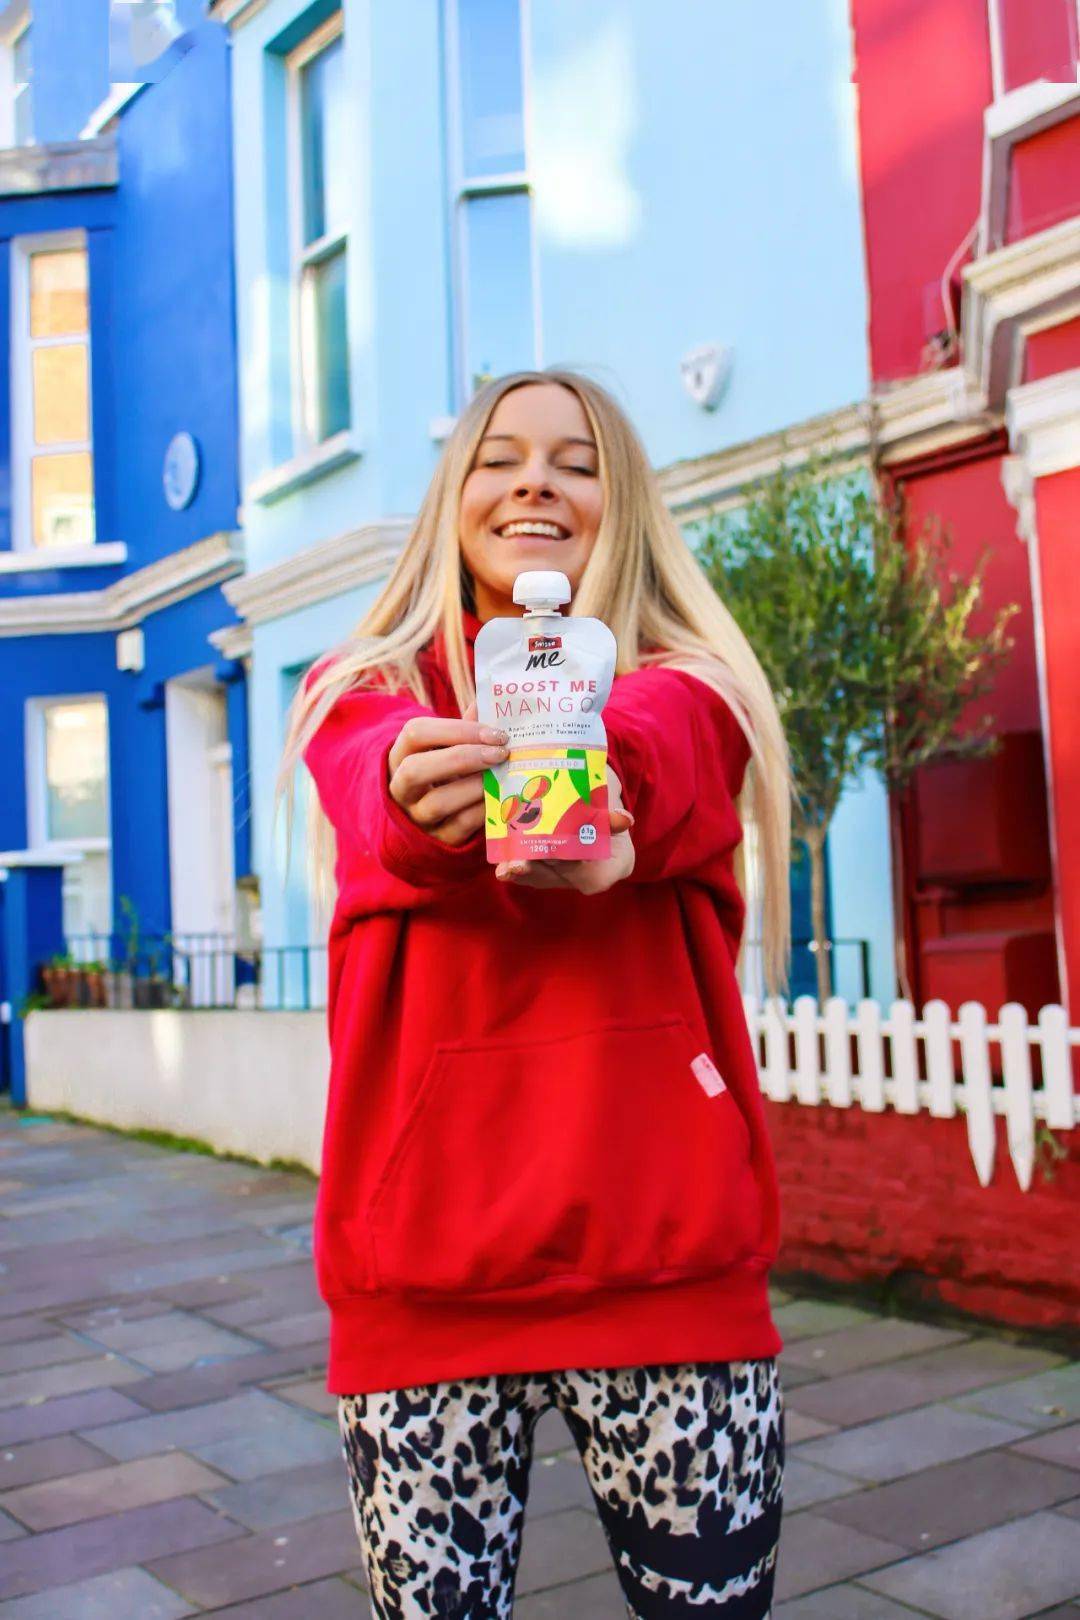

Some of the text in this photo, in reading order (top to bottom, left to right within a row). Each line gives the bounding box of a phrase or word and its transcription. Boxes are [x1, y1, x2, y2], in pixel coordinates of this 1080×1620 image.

[525, 651, 566, 671] me
[493, 680, 597, 697] BOOST ME
[495, 697, 594, 719] MANGO
